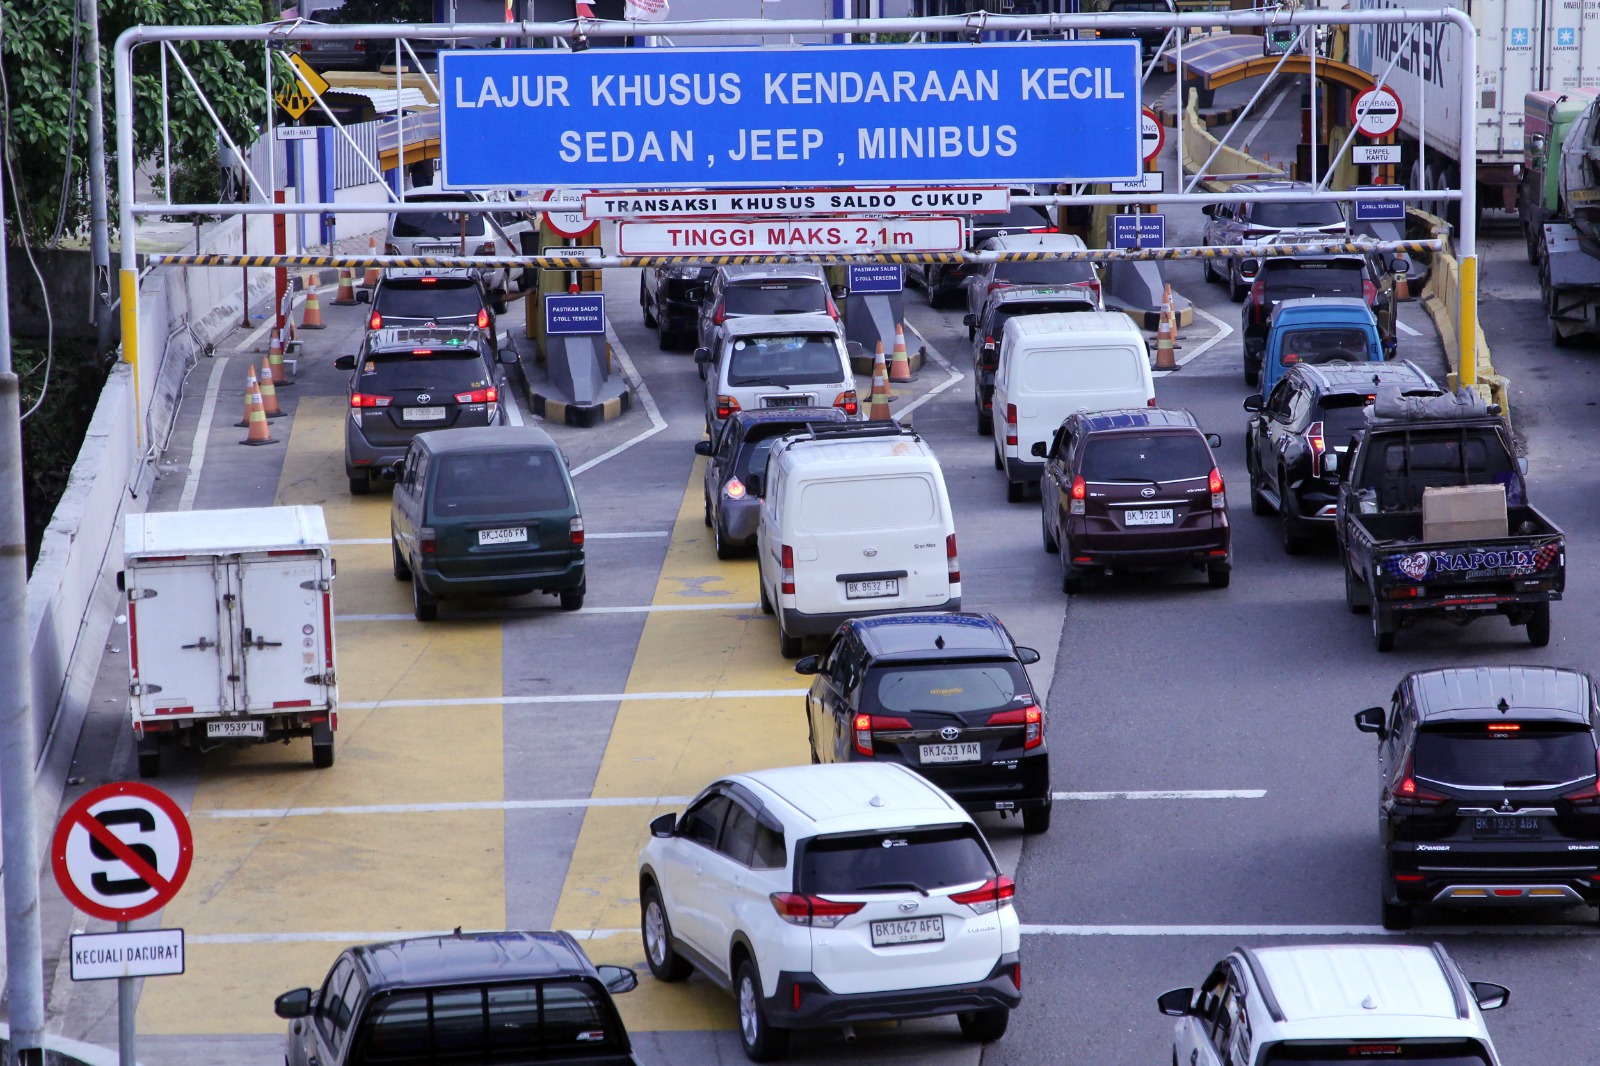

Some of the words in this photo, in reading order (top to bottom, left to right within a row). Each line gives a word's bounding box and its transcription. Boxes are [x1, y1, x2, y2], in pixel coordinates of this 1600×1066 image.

[455, 75, 570, 108] LAJUR
[591, 72, 741, 106] KHUSUS
[765, 69, 998, 105] KENDARAAN
[1022, 67, 1125, 100] KECIL
[858, 125, 1017, 160] MINIBUS
[605, 198, 717, 213] TRANSAKSI
[731, 196, 816, 210] KHUSUS
[830, 194, 897, 208] SALDO
[911, 193, 984, 207] CUKUP
[564, 214, 580, 223] TOL
[667, 228, 755, 247] TINGGI
[767, 228, 848, 246] MAKS.
[1127, 511, 1138, 520] BK
[1161, 510, 1171, 519] UK
[481, 531, 491, 540] BK
[1435, 550, 1539, 572] NAPOLLY
[885, 580, 895, 590] FT
[208, 723, 220, 733] BM
[224, 722, 247, 732] 9539
[250, 722, 262, 732] LN
[960, 743, 978, 755] YAK
[1476, 817, 1488, 829] BK
[919, 918, 940, 933] AFC
[75, 948, 123, 965] KECUALI
